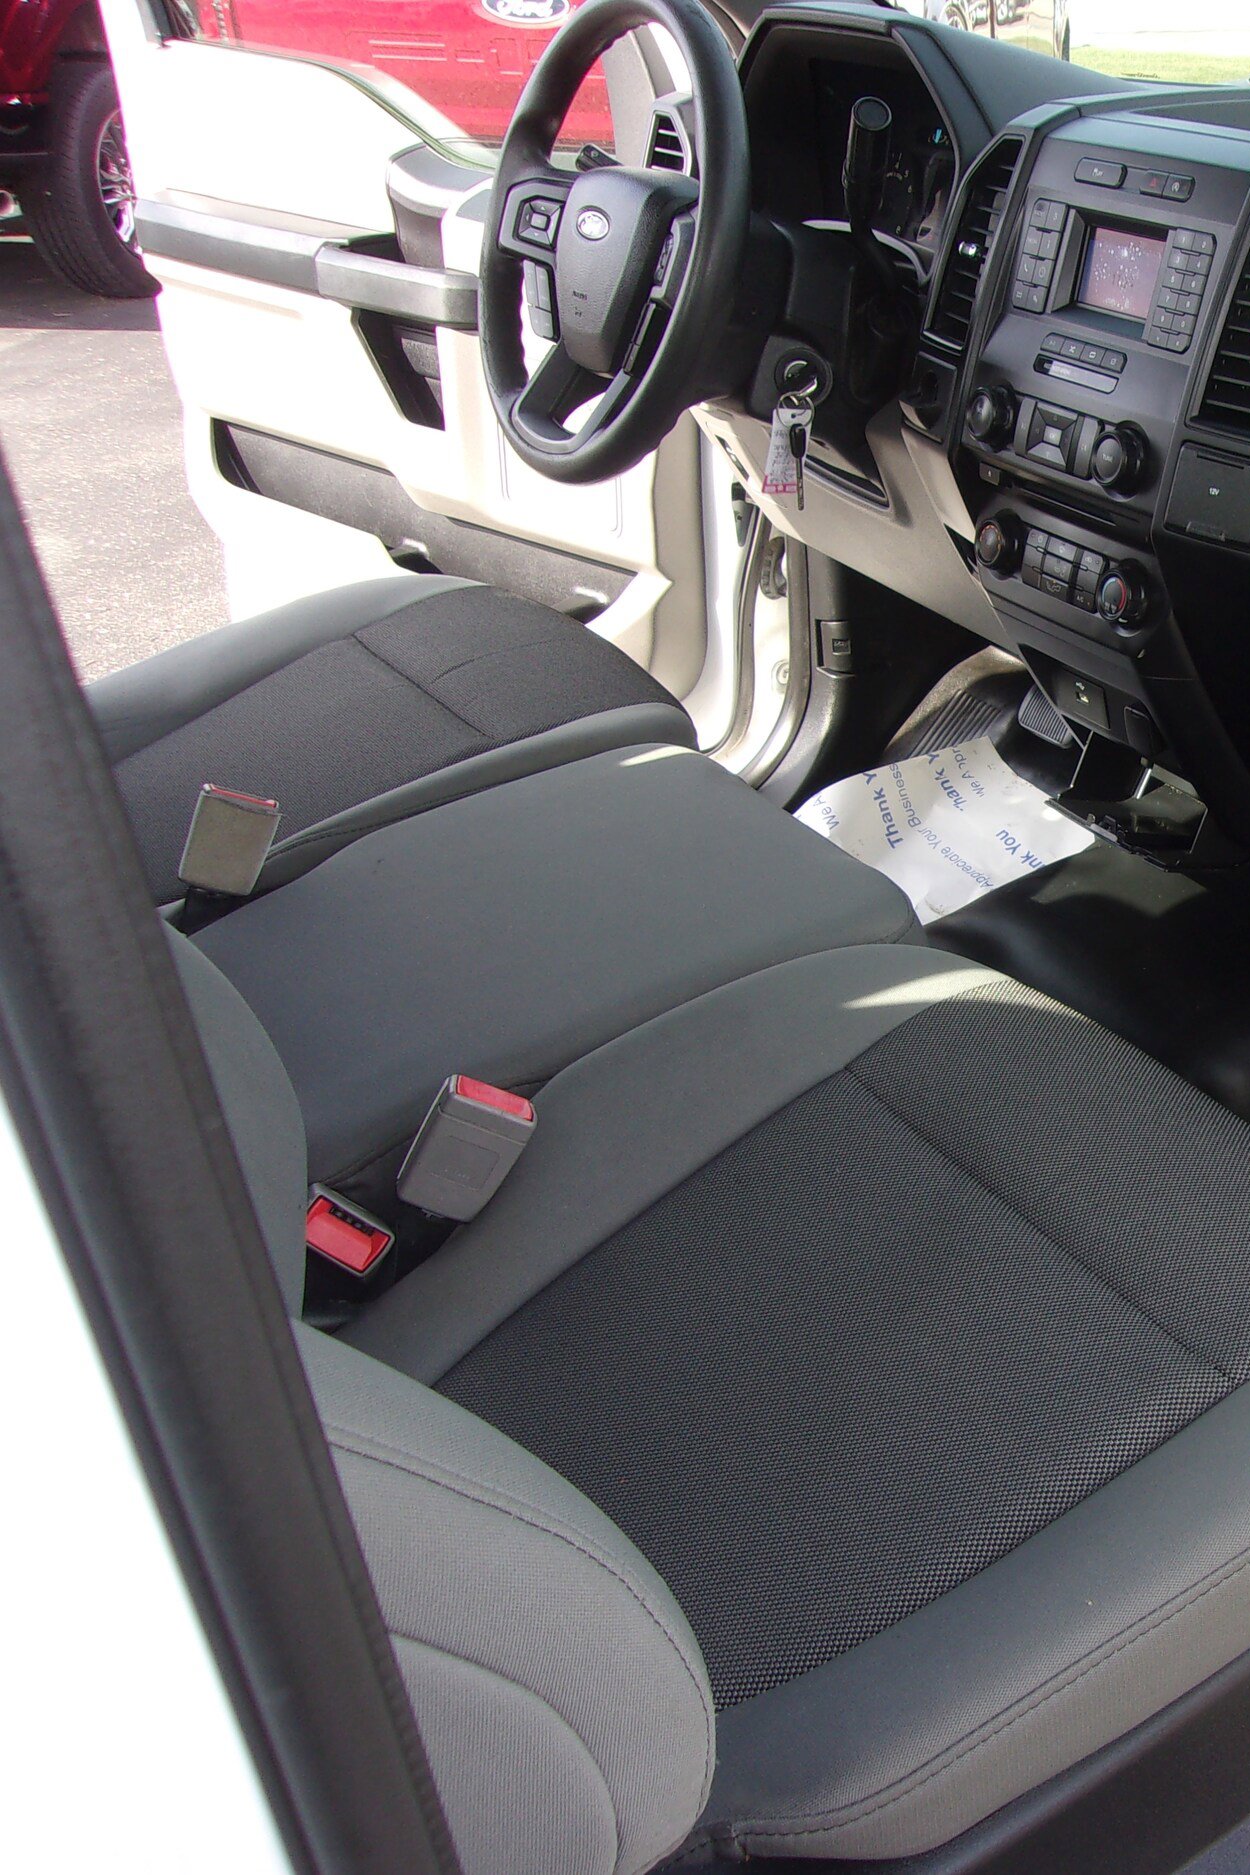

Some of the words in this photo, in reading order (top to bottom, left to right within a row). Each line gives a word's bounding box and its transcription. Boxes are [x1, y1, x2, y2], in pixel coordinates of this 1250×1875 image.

[1209, 487, 1220, 496] 12V
[889, 763, 922, 828] Business
[934, 767, 967, 811] hank
[821, 806, 840, 830] We
[873, 787, 904, 849] Thank
[917, 827, 942, 850] Your
[995, 829, 1022, 855] You
[940, 846, 994, 888] Appreciate
